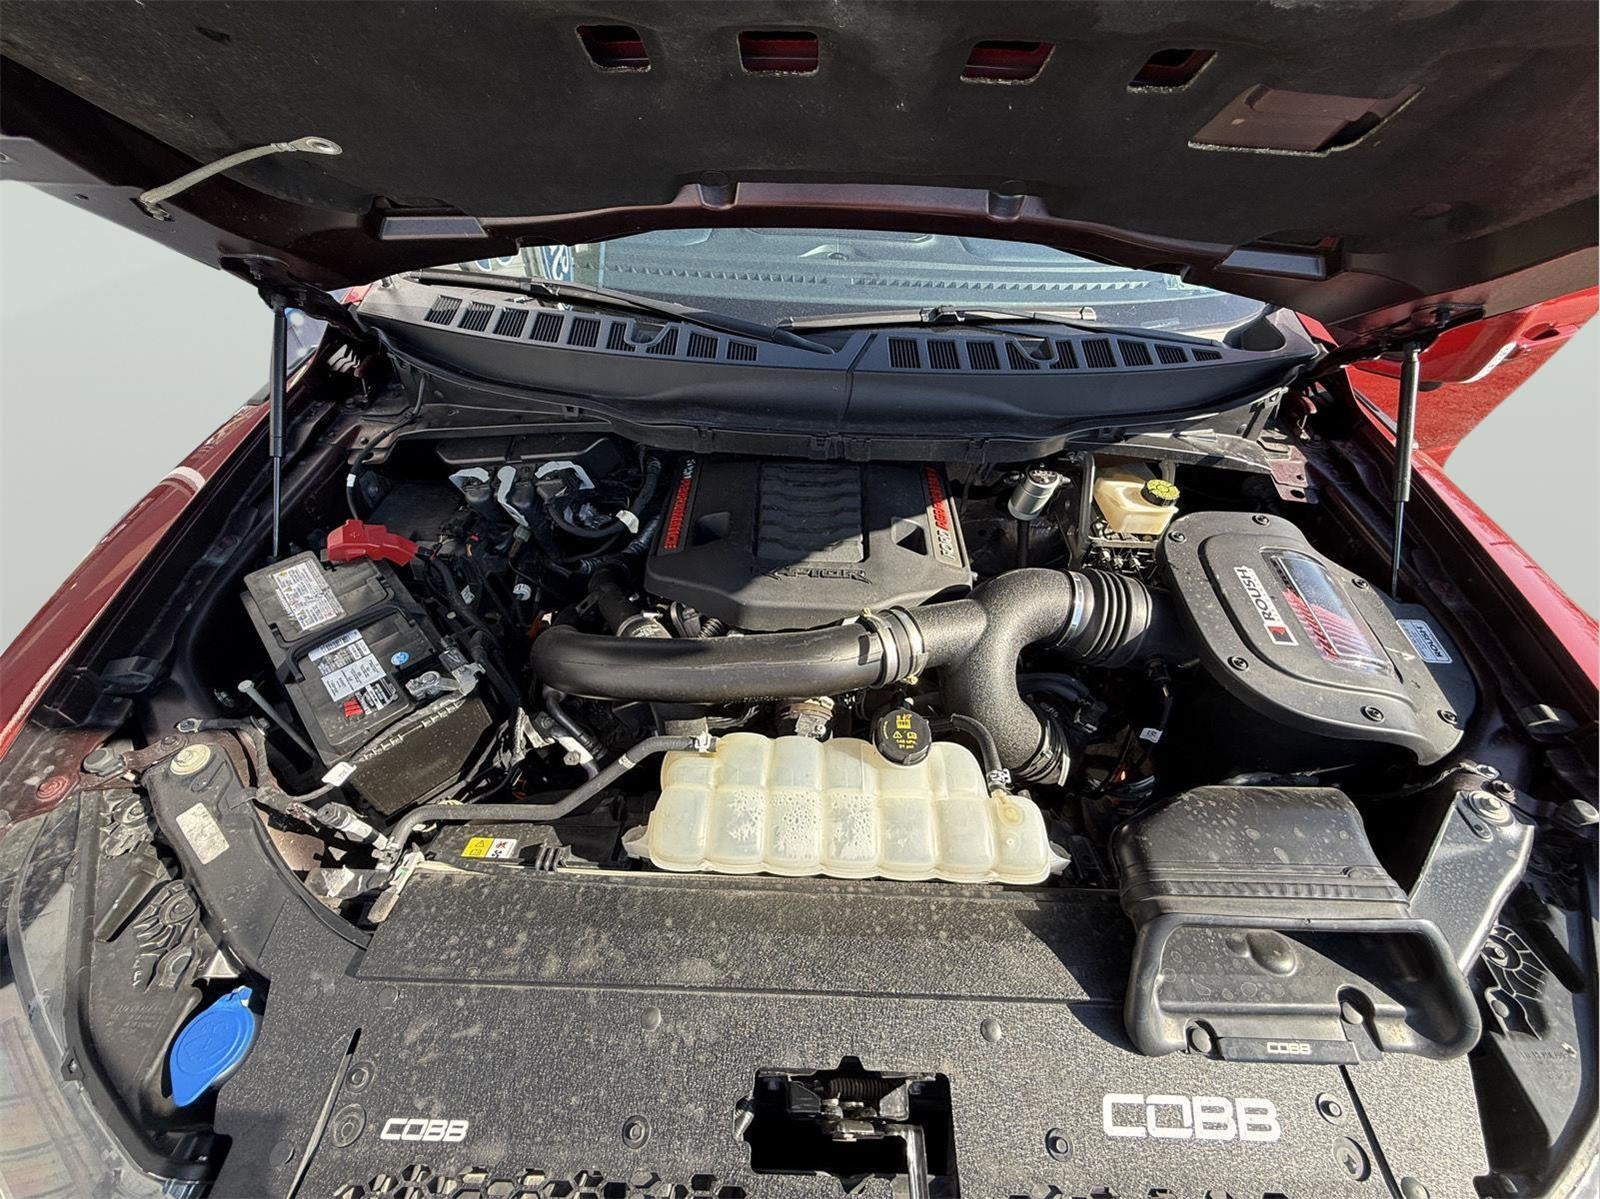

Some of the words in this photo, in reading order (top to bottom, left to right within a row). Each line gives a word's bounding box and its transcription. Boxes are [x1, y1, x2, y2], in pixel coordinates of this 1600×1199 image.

[1236, 568, 1276, 622] ROUSH
[1266, 1042, 1313, 1055] COBB
[380, 1117, 470, 1142] COBB
[1103, 1093, 1282, 1142] COBB
